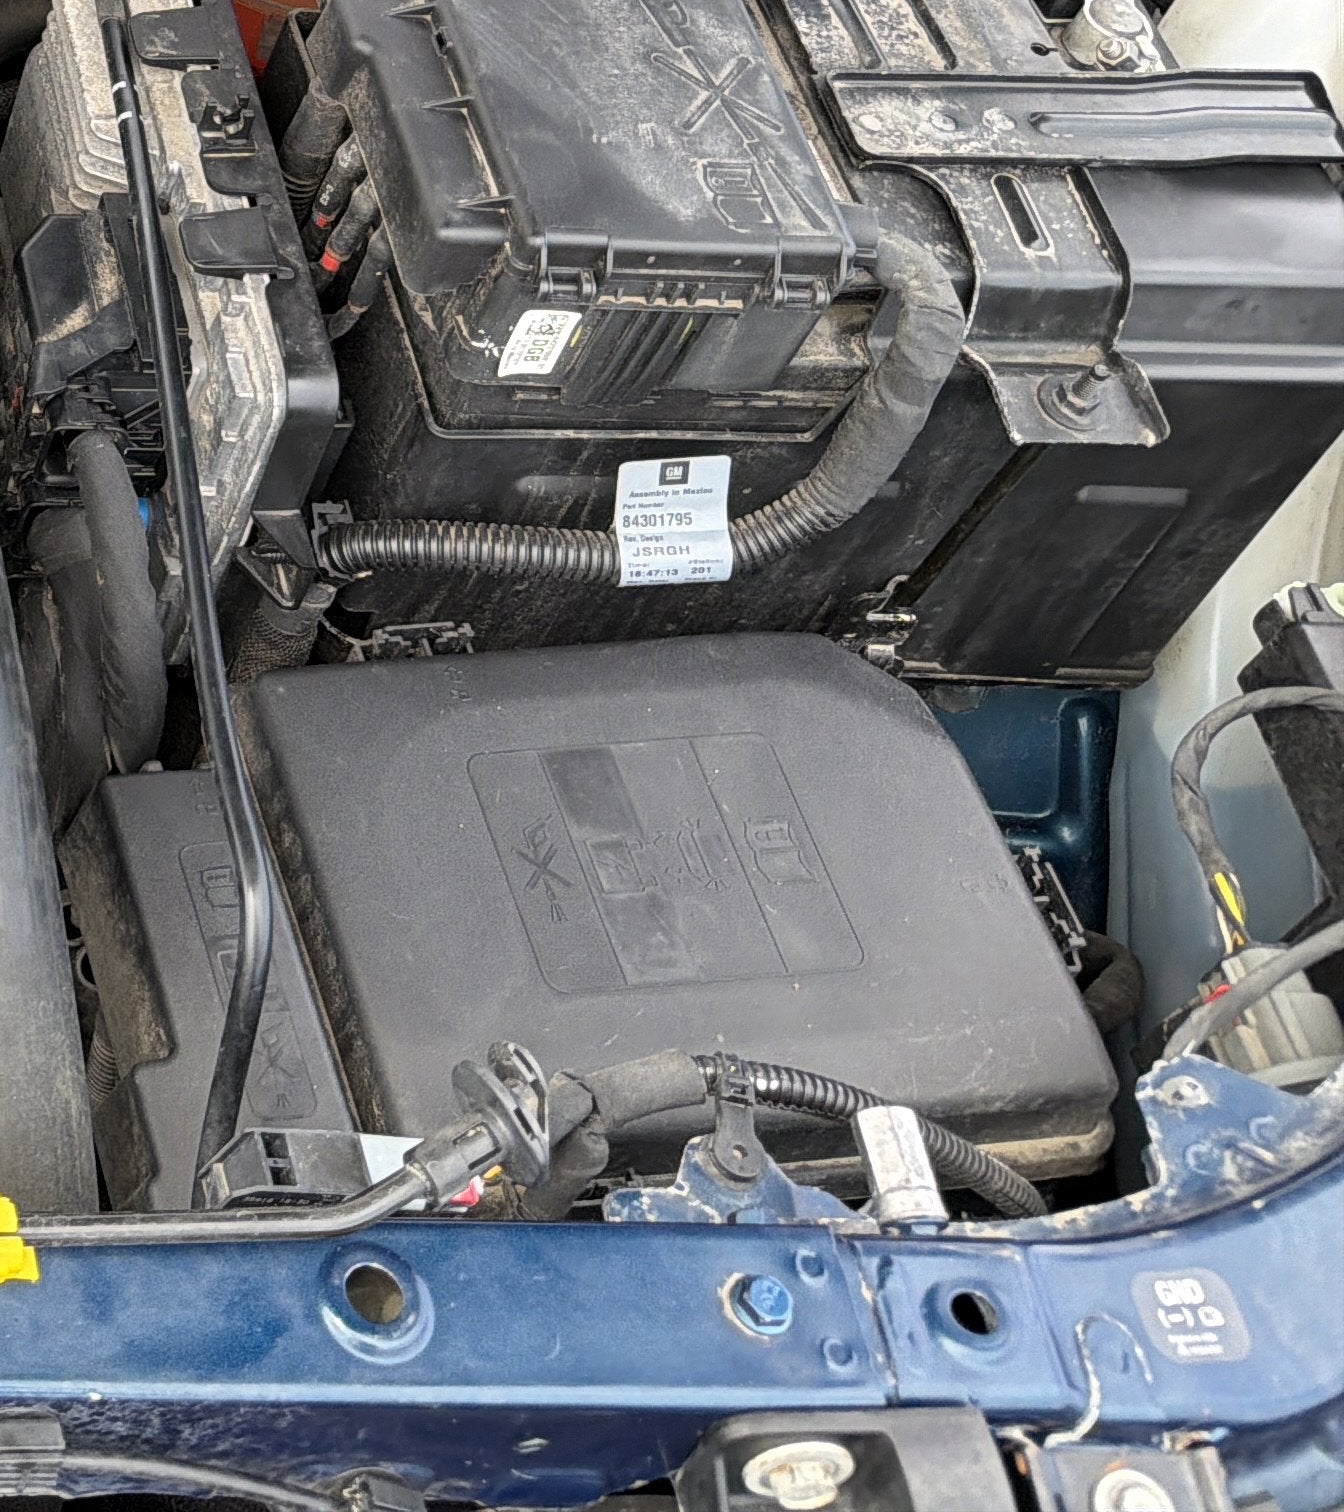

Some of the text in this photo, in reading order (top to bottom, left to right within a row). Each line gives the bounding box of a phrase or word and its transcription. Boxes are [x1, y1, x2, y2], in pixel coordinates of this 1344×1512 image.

[665, 466, 683, 477] GM
[622, 512, 693, 528] 84301795
[632, 546, 690, 557] JSRGH
[691, 567, 712, 575] 201
[1155, 1278, 1205, 1306] GND
